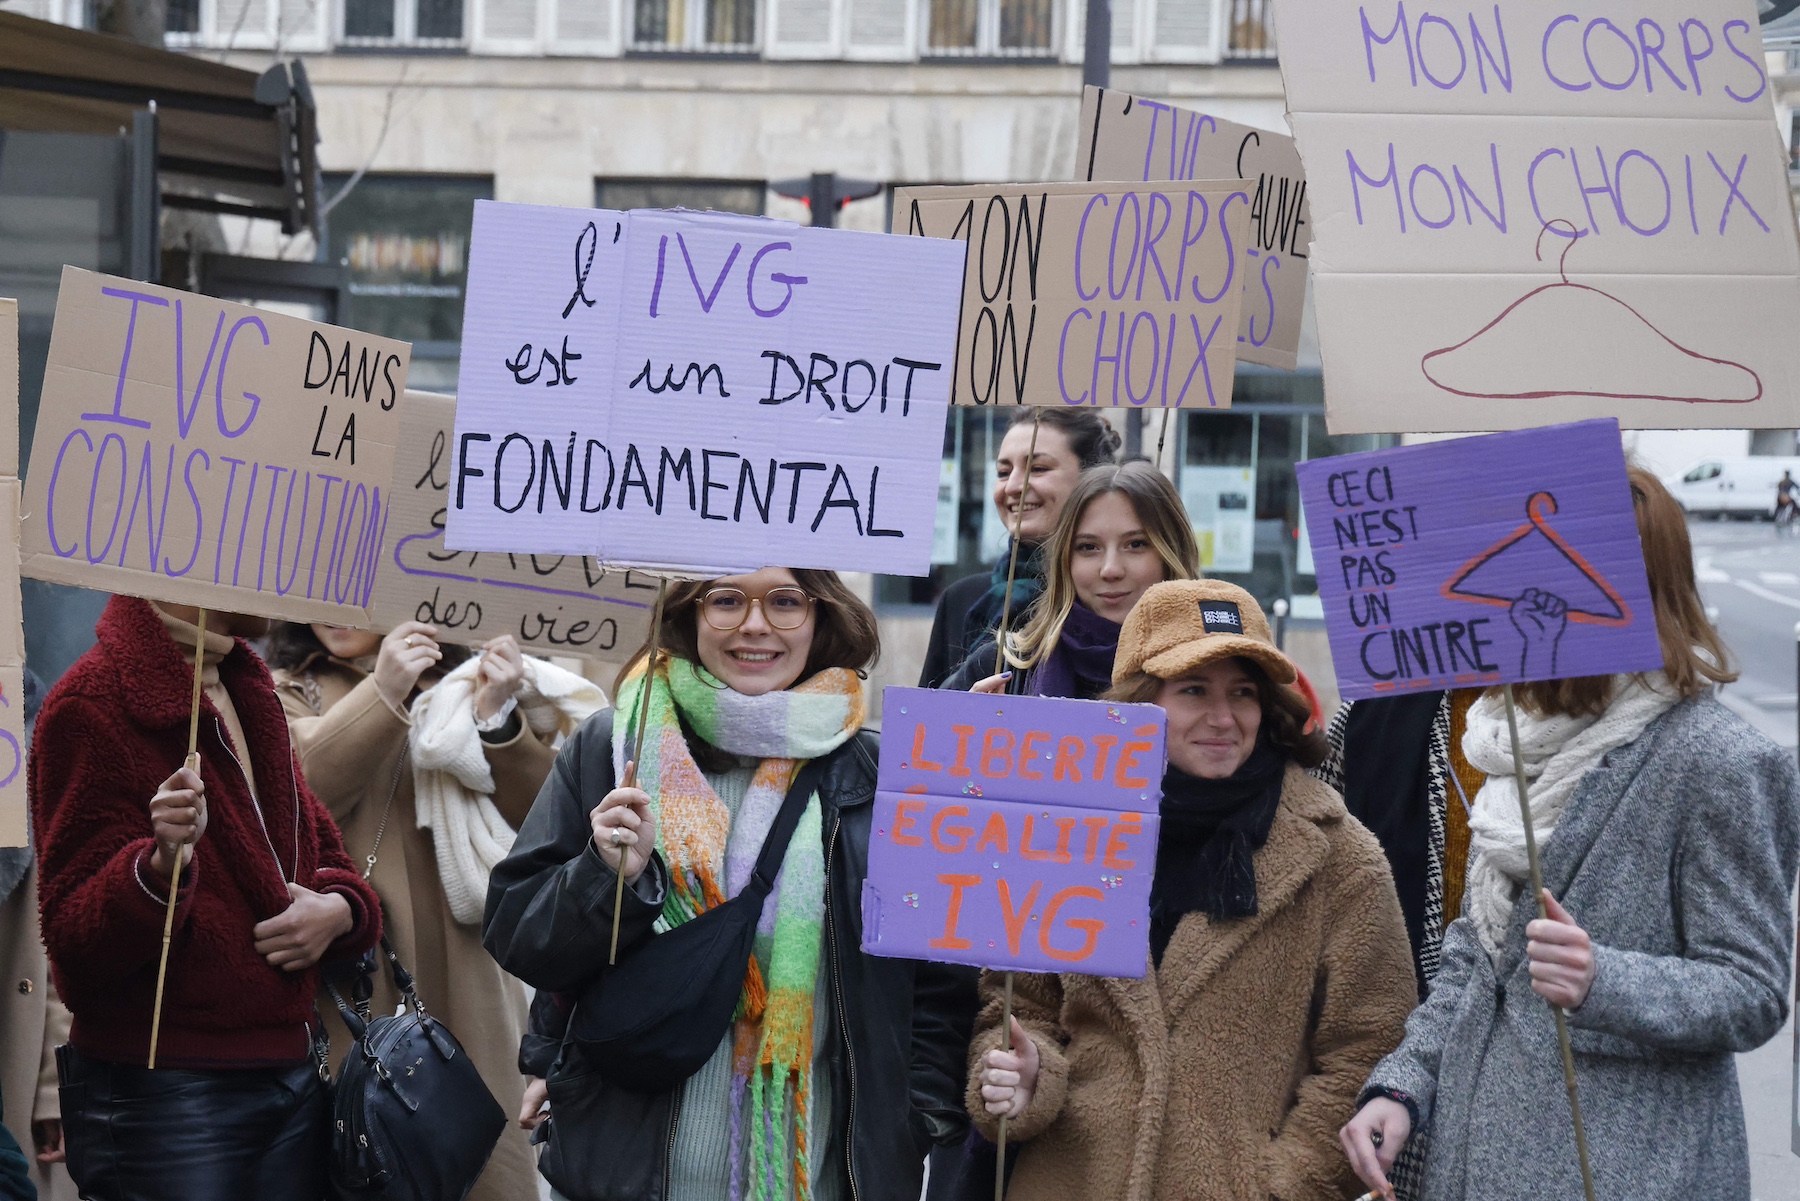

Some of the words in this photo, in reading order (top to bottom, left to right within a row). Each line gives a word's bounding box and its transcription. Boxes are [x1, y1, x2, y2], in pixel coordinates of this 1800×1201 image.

[1358, 0, 1513, 94] MON
[1542, 14, 1766, 103] CORPS
[1346, 142, 1507, 234] MON
[1527, 145, 1770, 238] CHOIX
[1075, 191, 1249, 305] CORPS
[81, 286, 270, 440] IVG
[304, 331, 401, 411] DANS
[505, 335, 582, 388] est
[629, 359, 731, 398] un
[758, 350, 942, 417] DROIT
[953, 303, 1037, 406] ON
[1057, 307, 1222, 407] CHOIX
[311, 405, 355, 465] LA
[47, 428, 391, 608] CONSTITUTION
[456, 431, 904, 537] FONDAMENTAL
[1328, 466, 1394, 508] CECI
[1333, 505, 1419, 550] N'EST
[1341, 551, 1397, 590] PAS
[1348, 592, 1392, 627] UN
[415, 586, 483, 630] des
[520, 605, 618, 650] vies
[1360, 618, 1499, 681] CINTRE
[911, 723, 1159, 789] LIBERTÉ
[890, 783, 1142, 870] ÉGALITÉ
[928, 873, 1106, 962] IVG
